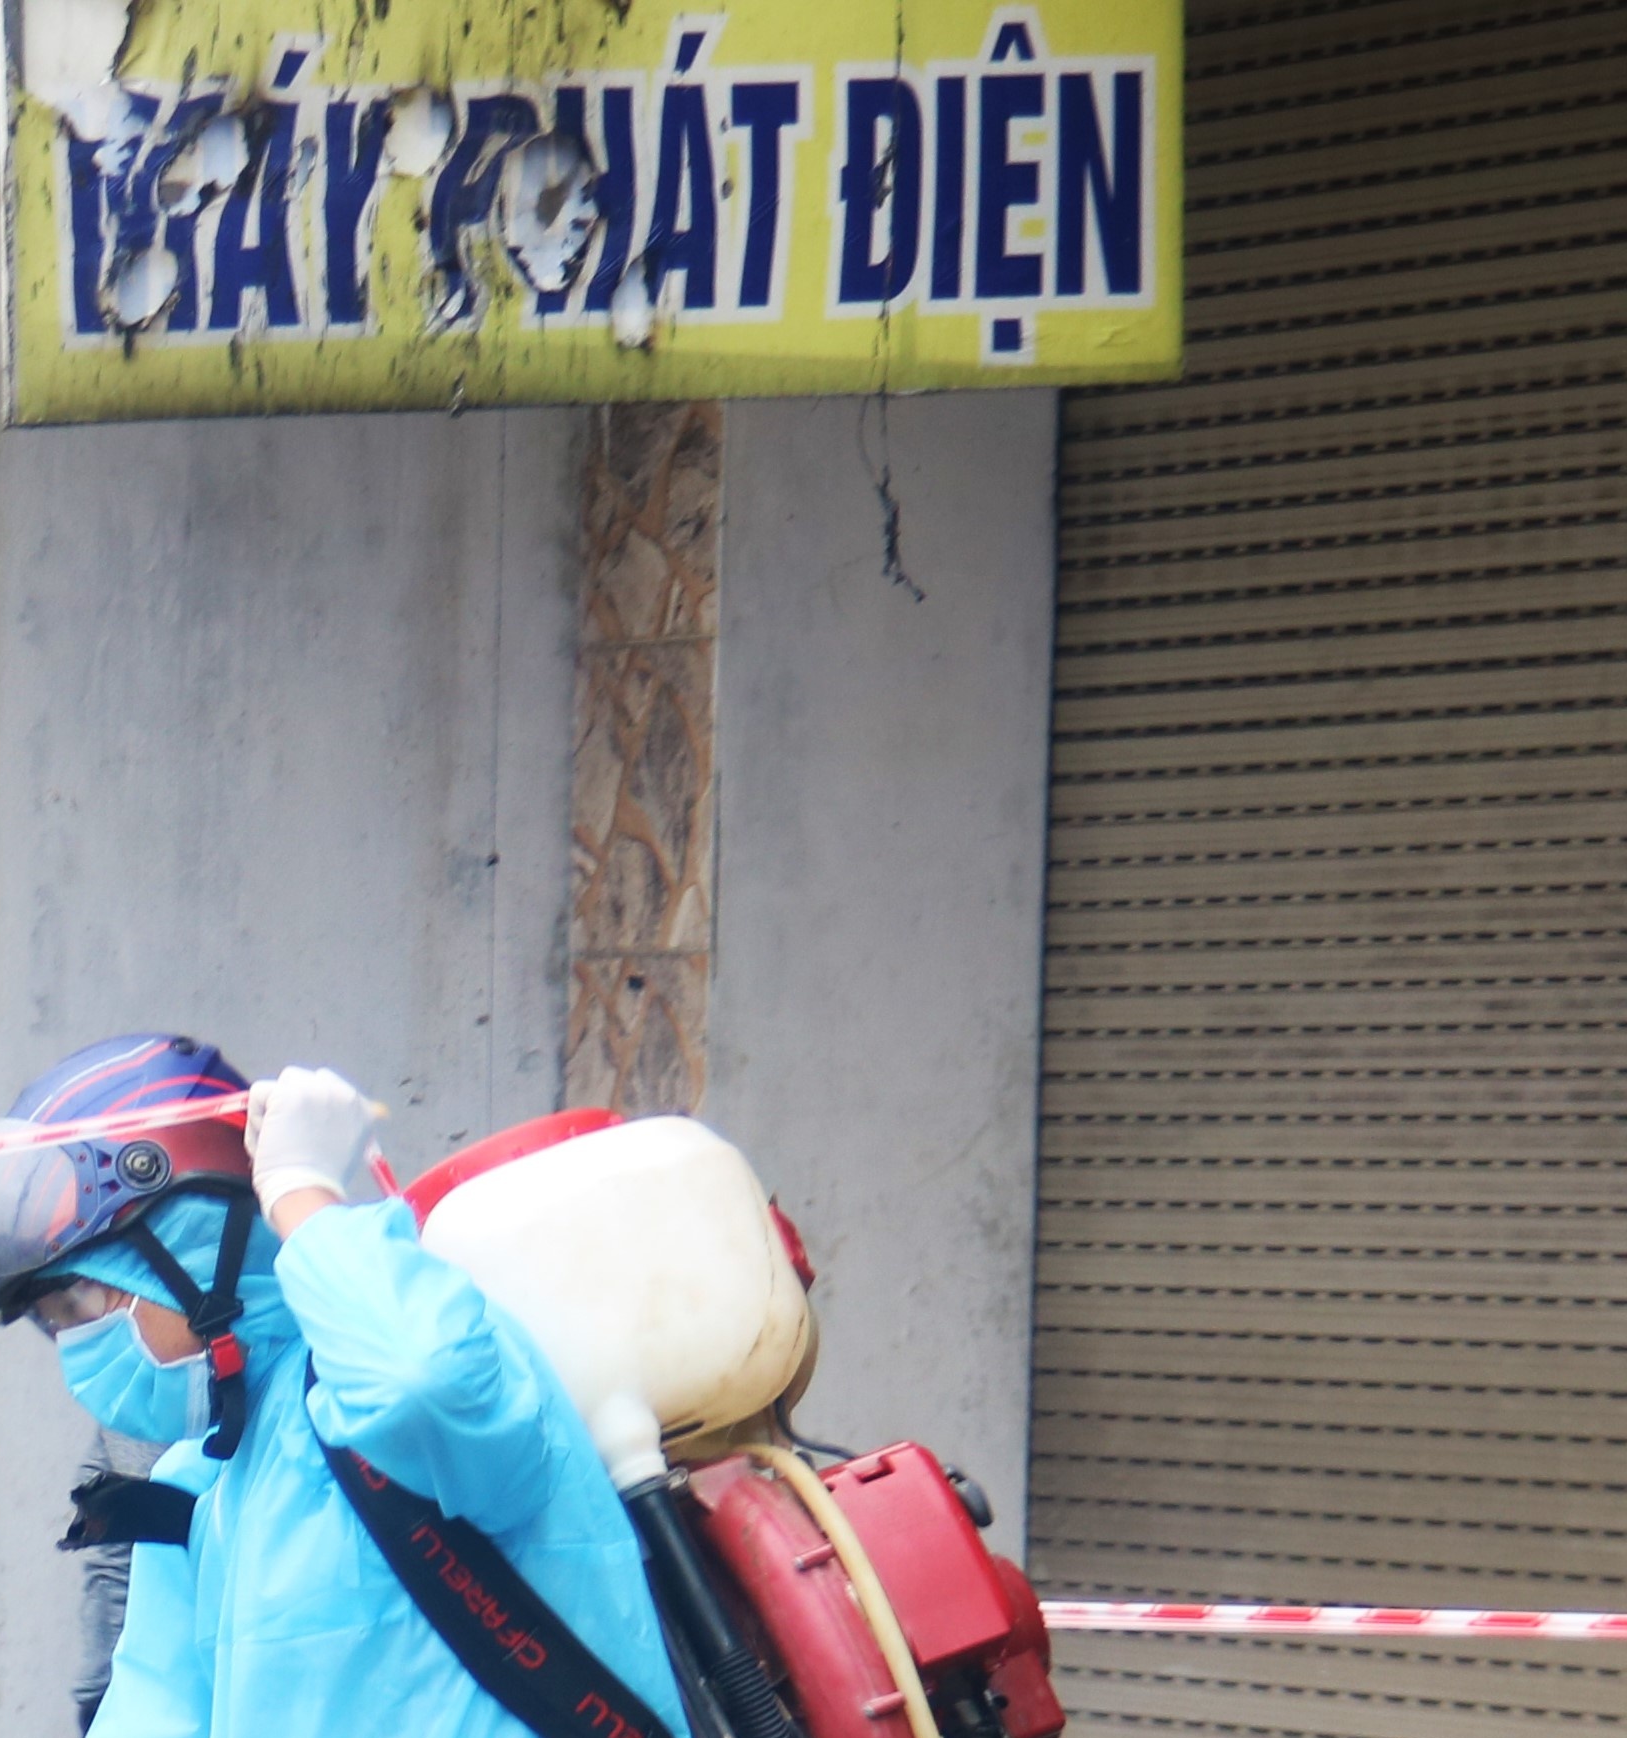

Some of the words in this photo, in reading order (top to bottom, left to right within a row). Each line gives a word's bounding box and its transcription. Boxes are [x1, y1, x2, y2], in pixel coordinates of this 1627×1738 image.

[430, 31, 800, 322] PHÁT
[840, 20, 1144, 352] ĐIỆN
[411, 1525, 547, 1671] CIFARELLI
